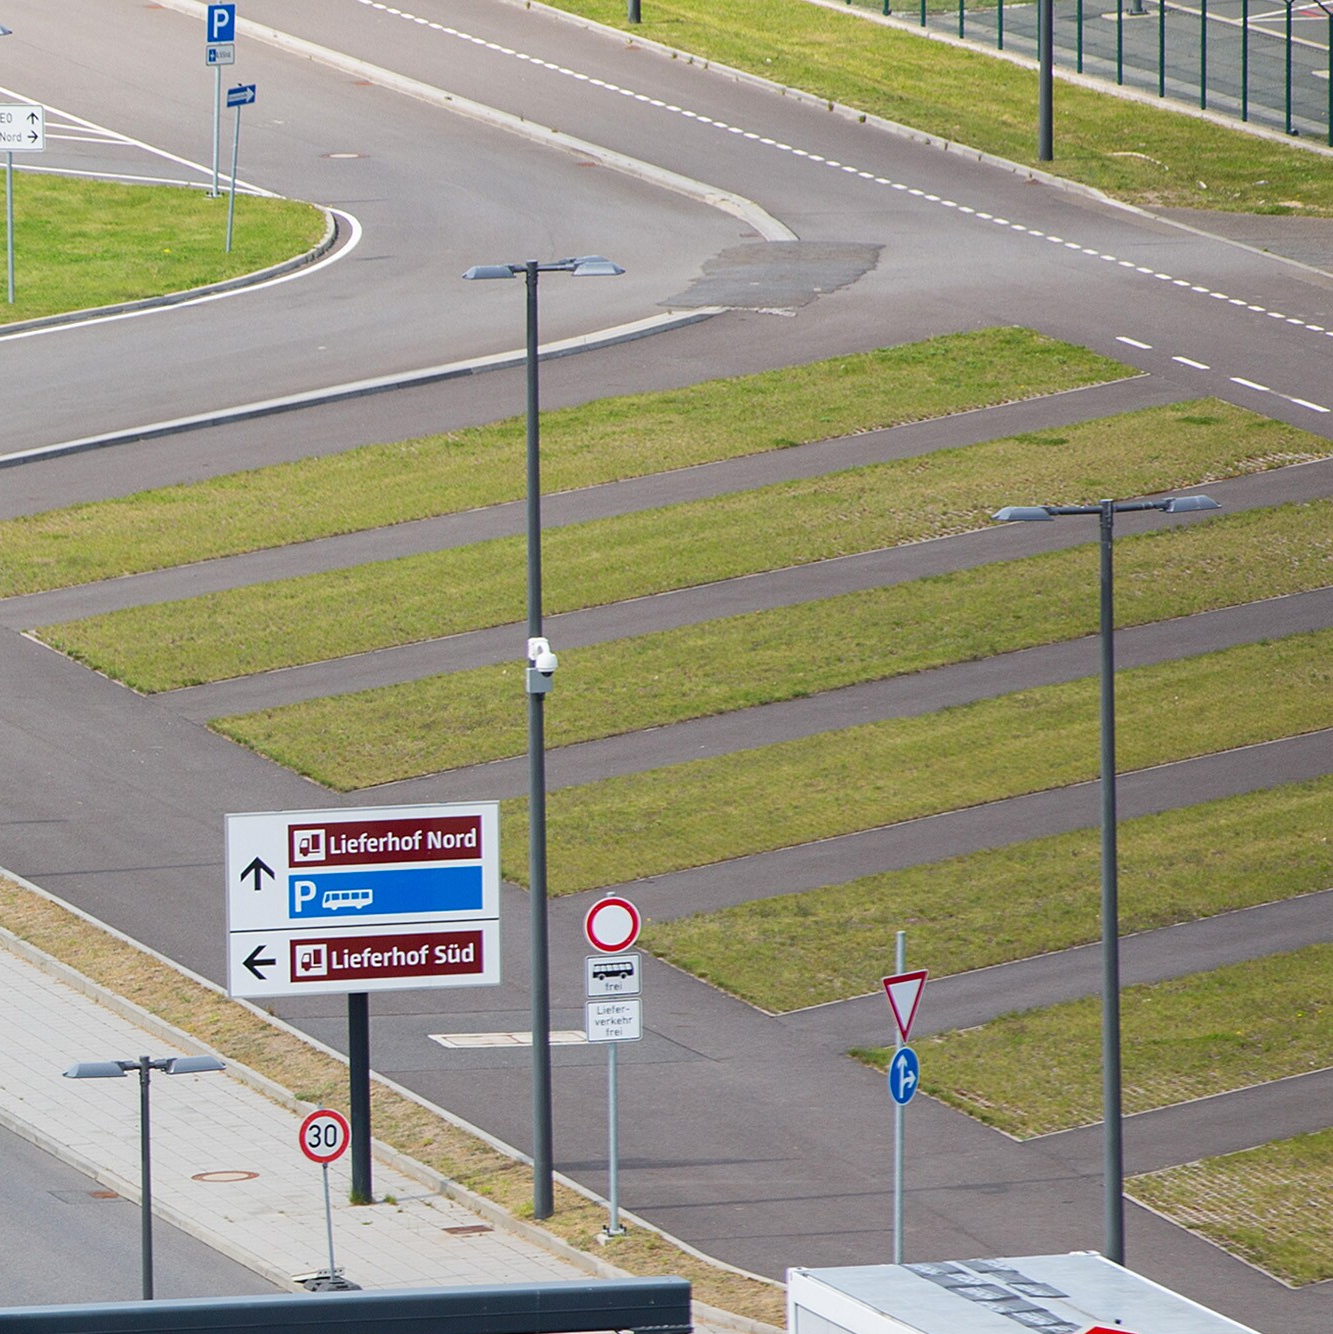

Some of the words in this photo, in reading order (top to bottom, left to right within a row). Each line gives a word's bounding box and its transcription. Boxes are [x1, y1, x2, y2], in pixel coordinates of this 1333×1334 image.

[214, 9, 229, 38] P
[0, 131, 22, 142] Nord
[329, 831, 422, 855] Lieferhof
[427, 827, 476, 850] Nord
[294, 880, 317, 913] P
[332, 945, 429, 969] Lieferhof
[434, 943, 475, 964] Süd
[605, 982, 622, 991] frei
[597, 1005, 630, 1015] Liefer-
[595, 1017, 633, 1026] verkehr
[606, 1028, 623, 1036] frei
[309, 1124, 337, 1148] 30
